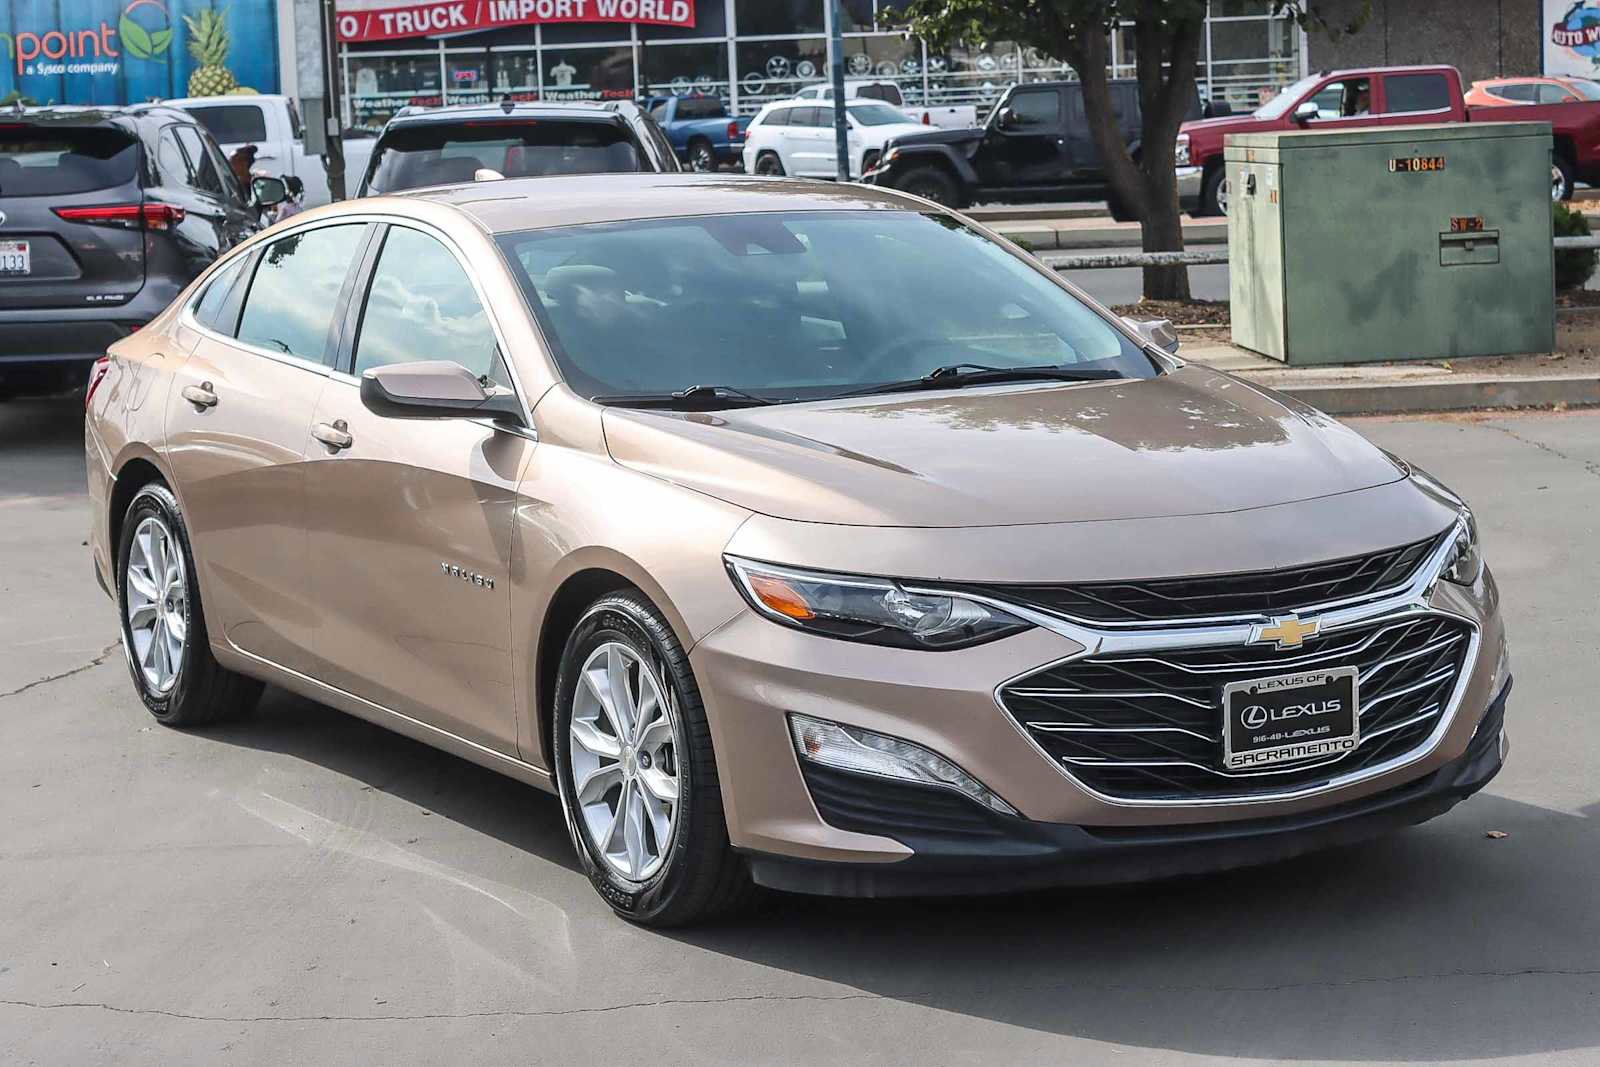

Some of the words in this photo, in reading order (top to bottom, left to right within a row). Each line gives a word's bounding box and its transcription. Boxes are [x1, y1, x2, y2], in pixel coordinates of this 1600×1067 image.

[336, 15, 359, 38] O
[379, 4, 468, 35] TRUCK
[489, 0, 587, 22] IMPORT
[596, 0, 690, 25] WORLD
[26, 65, 34, 75] a
[36, 62, 66, 76] Sysco
[67, 62, 118, 76] company
[1389, 158, 1444, 172] U-10844
[1257, 677, 1304, 690] LEXUS
[1306, 673, 1327, 683] OF
[1270, 699, 1341, 721] LEXUS
[1231, 738, 1355, 767] SACRAMENTO
